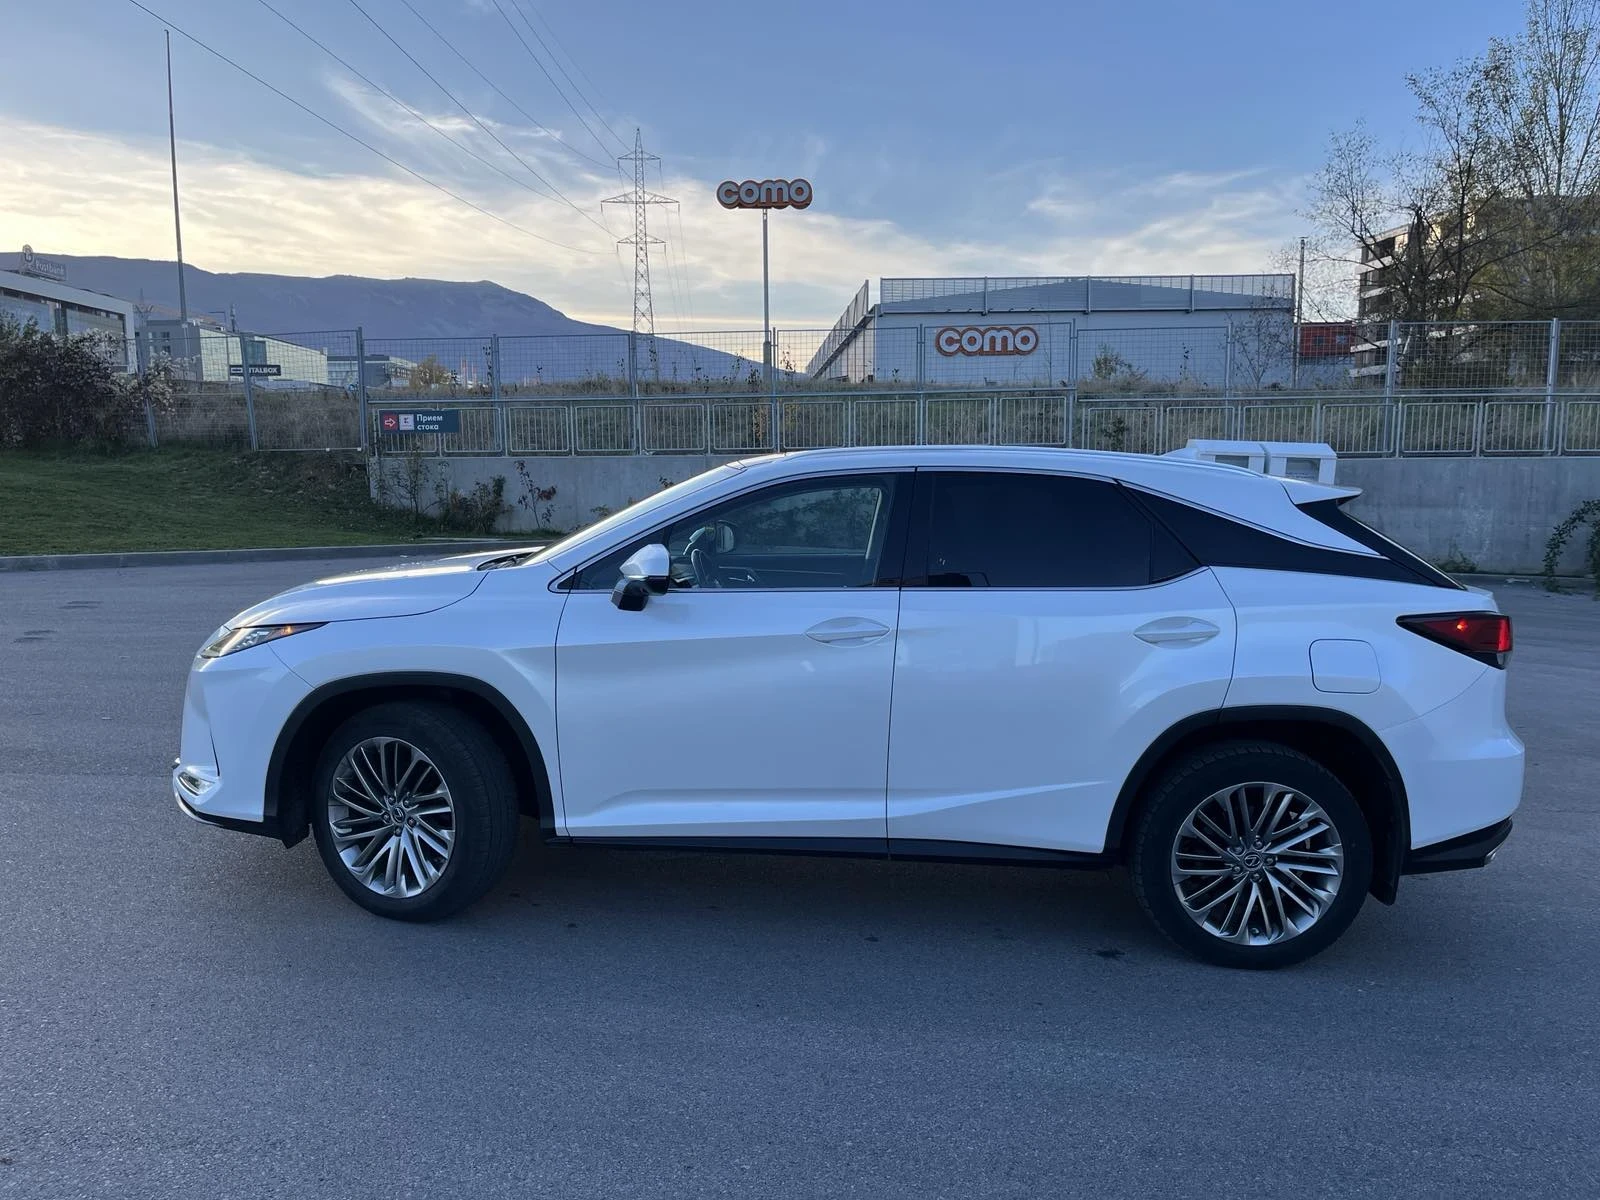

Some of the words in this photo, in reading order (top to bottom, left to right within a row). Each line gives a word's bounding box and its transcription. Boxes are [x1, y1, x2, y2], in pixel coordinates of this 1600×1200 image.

[718, 180, 811, 205] como
[939, 329, 1037, 352] como
[416, 413, 443, 423] Прием
